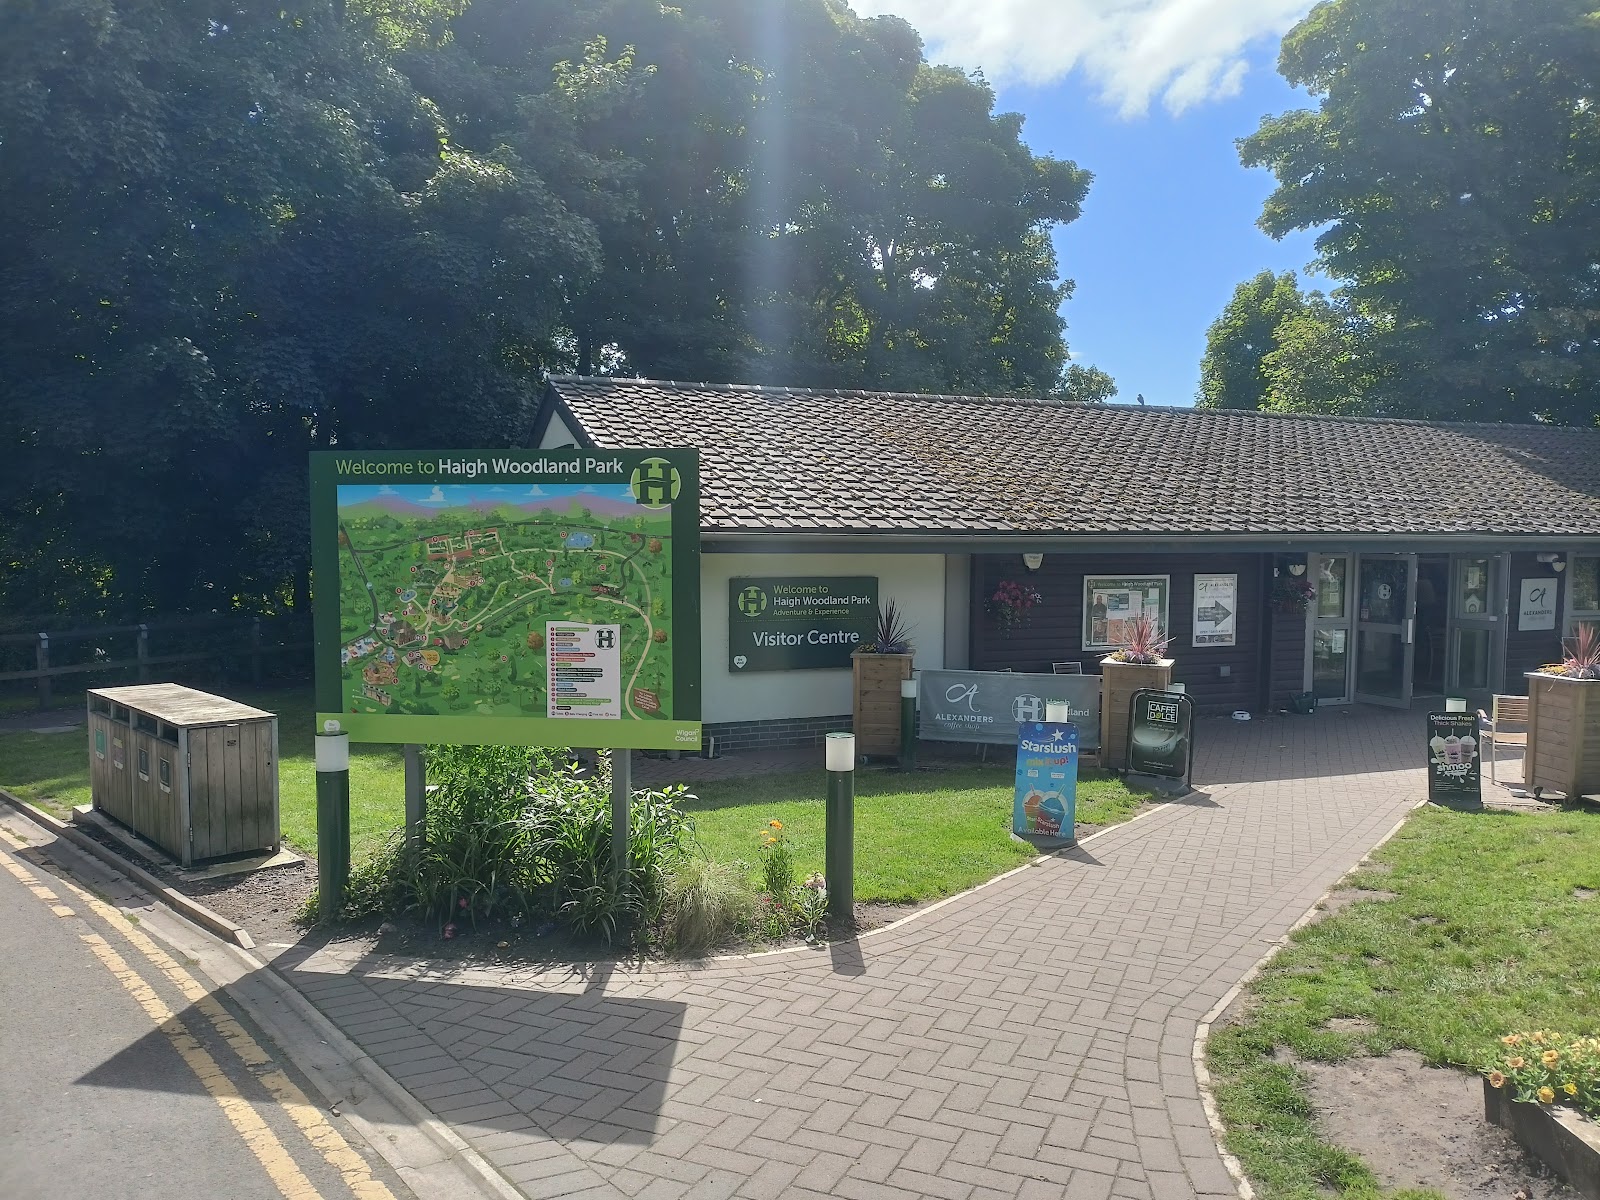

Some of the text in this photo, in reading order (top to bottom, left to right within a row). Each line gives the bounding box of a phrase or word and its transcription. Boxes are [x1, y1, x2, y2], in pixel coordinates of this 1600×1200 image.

[335, 458, 624, 478] Welcome to Haigh Woodland Park
[773, 584, 829, 594] Welcome to
[773, 595, 871, 608] Haigh Woodland Park
[814, 608, 850, 617] Experience
[753, 629, 860, 647] Visitor Centre
[935, 713, 994, 723] ALEXANDERS
[943, 721, 980, 732] coffee shop
[676, 729, 696, 737] Wigan
[1021, 739, 1076, 754] Starslush
[1053, 756, 1069, 766] up!
[1437, 762, 1472, 772] shmoo
[1018, 826, 1066, 837] Available Here
